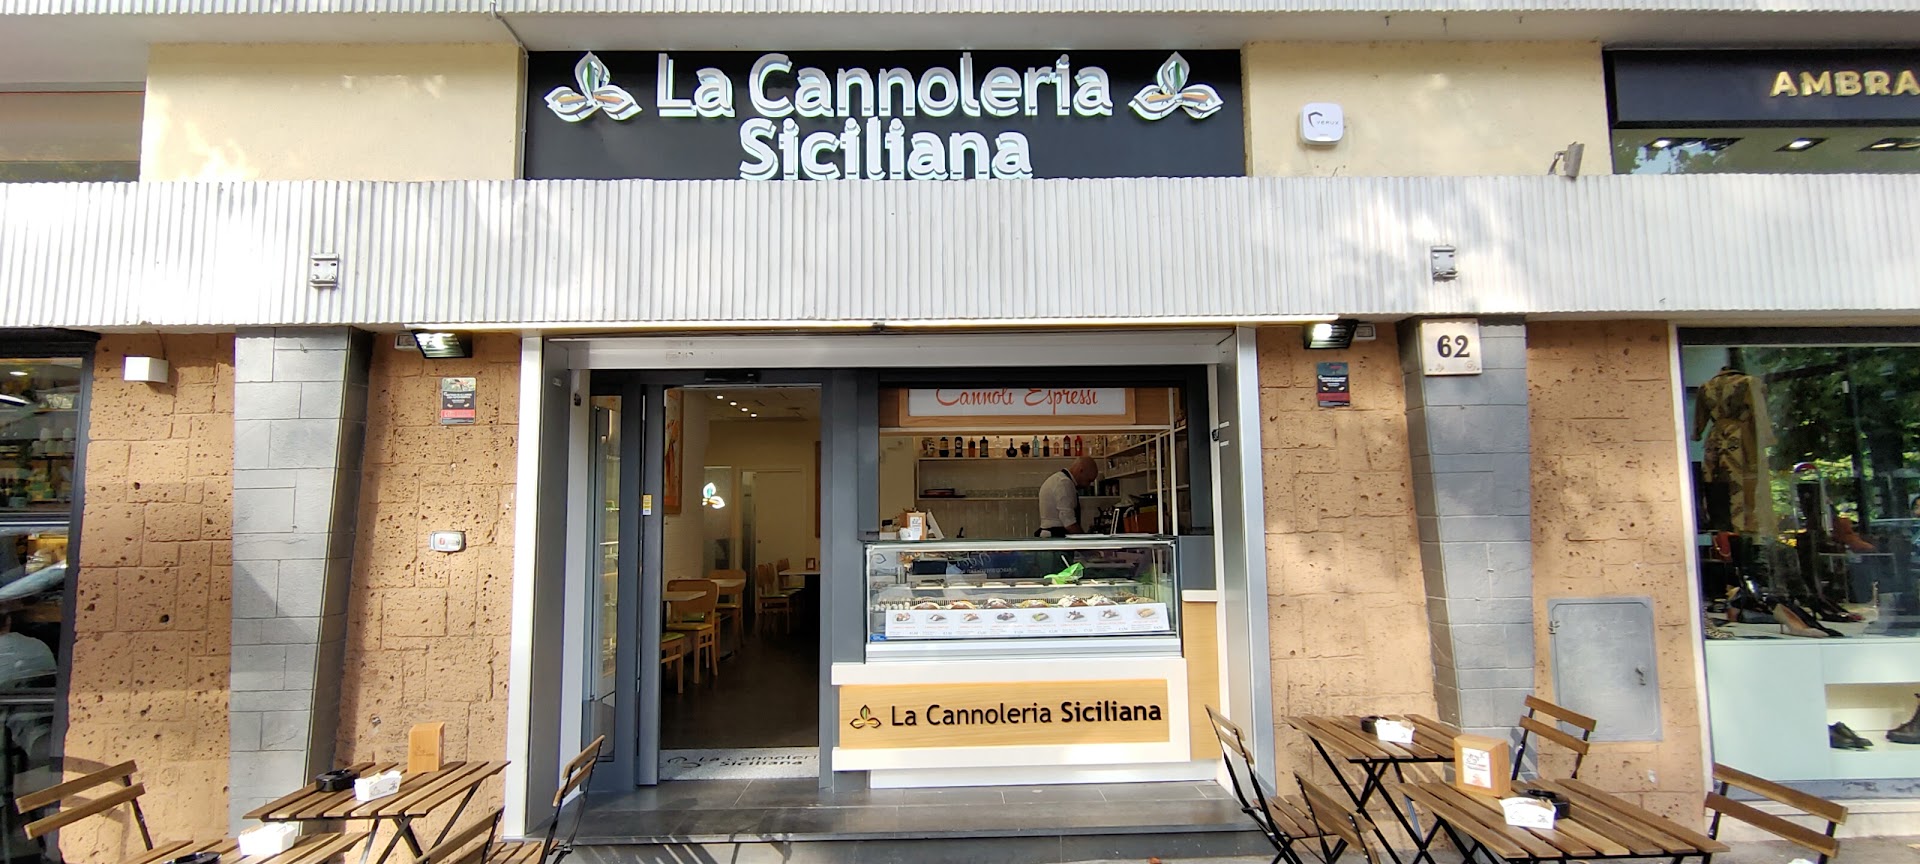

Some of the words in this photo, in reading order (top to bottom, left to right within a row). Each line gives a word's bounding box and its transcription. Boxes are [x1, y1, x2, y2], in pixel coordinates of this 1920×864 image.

[656, 53, 735, 117] La
[748, 51, 1113, 117] Cannoleria
[1769, 70, 1920, 97] AMBRA
[739, 116, 1033, 180] Siciliana
[1437, 334, 1470, 358] 62
[935, 388, 1014, 407] Cannoli
[1023, 388, 1099, 415] Espressi
[891, 705, 917, 726] La
[926, 702, 1052, 726] Cannoleria
[1060, 700, 1162, 722] Siciliana
